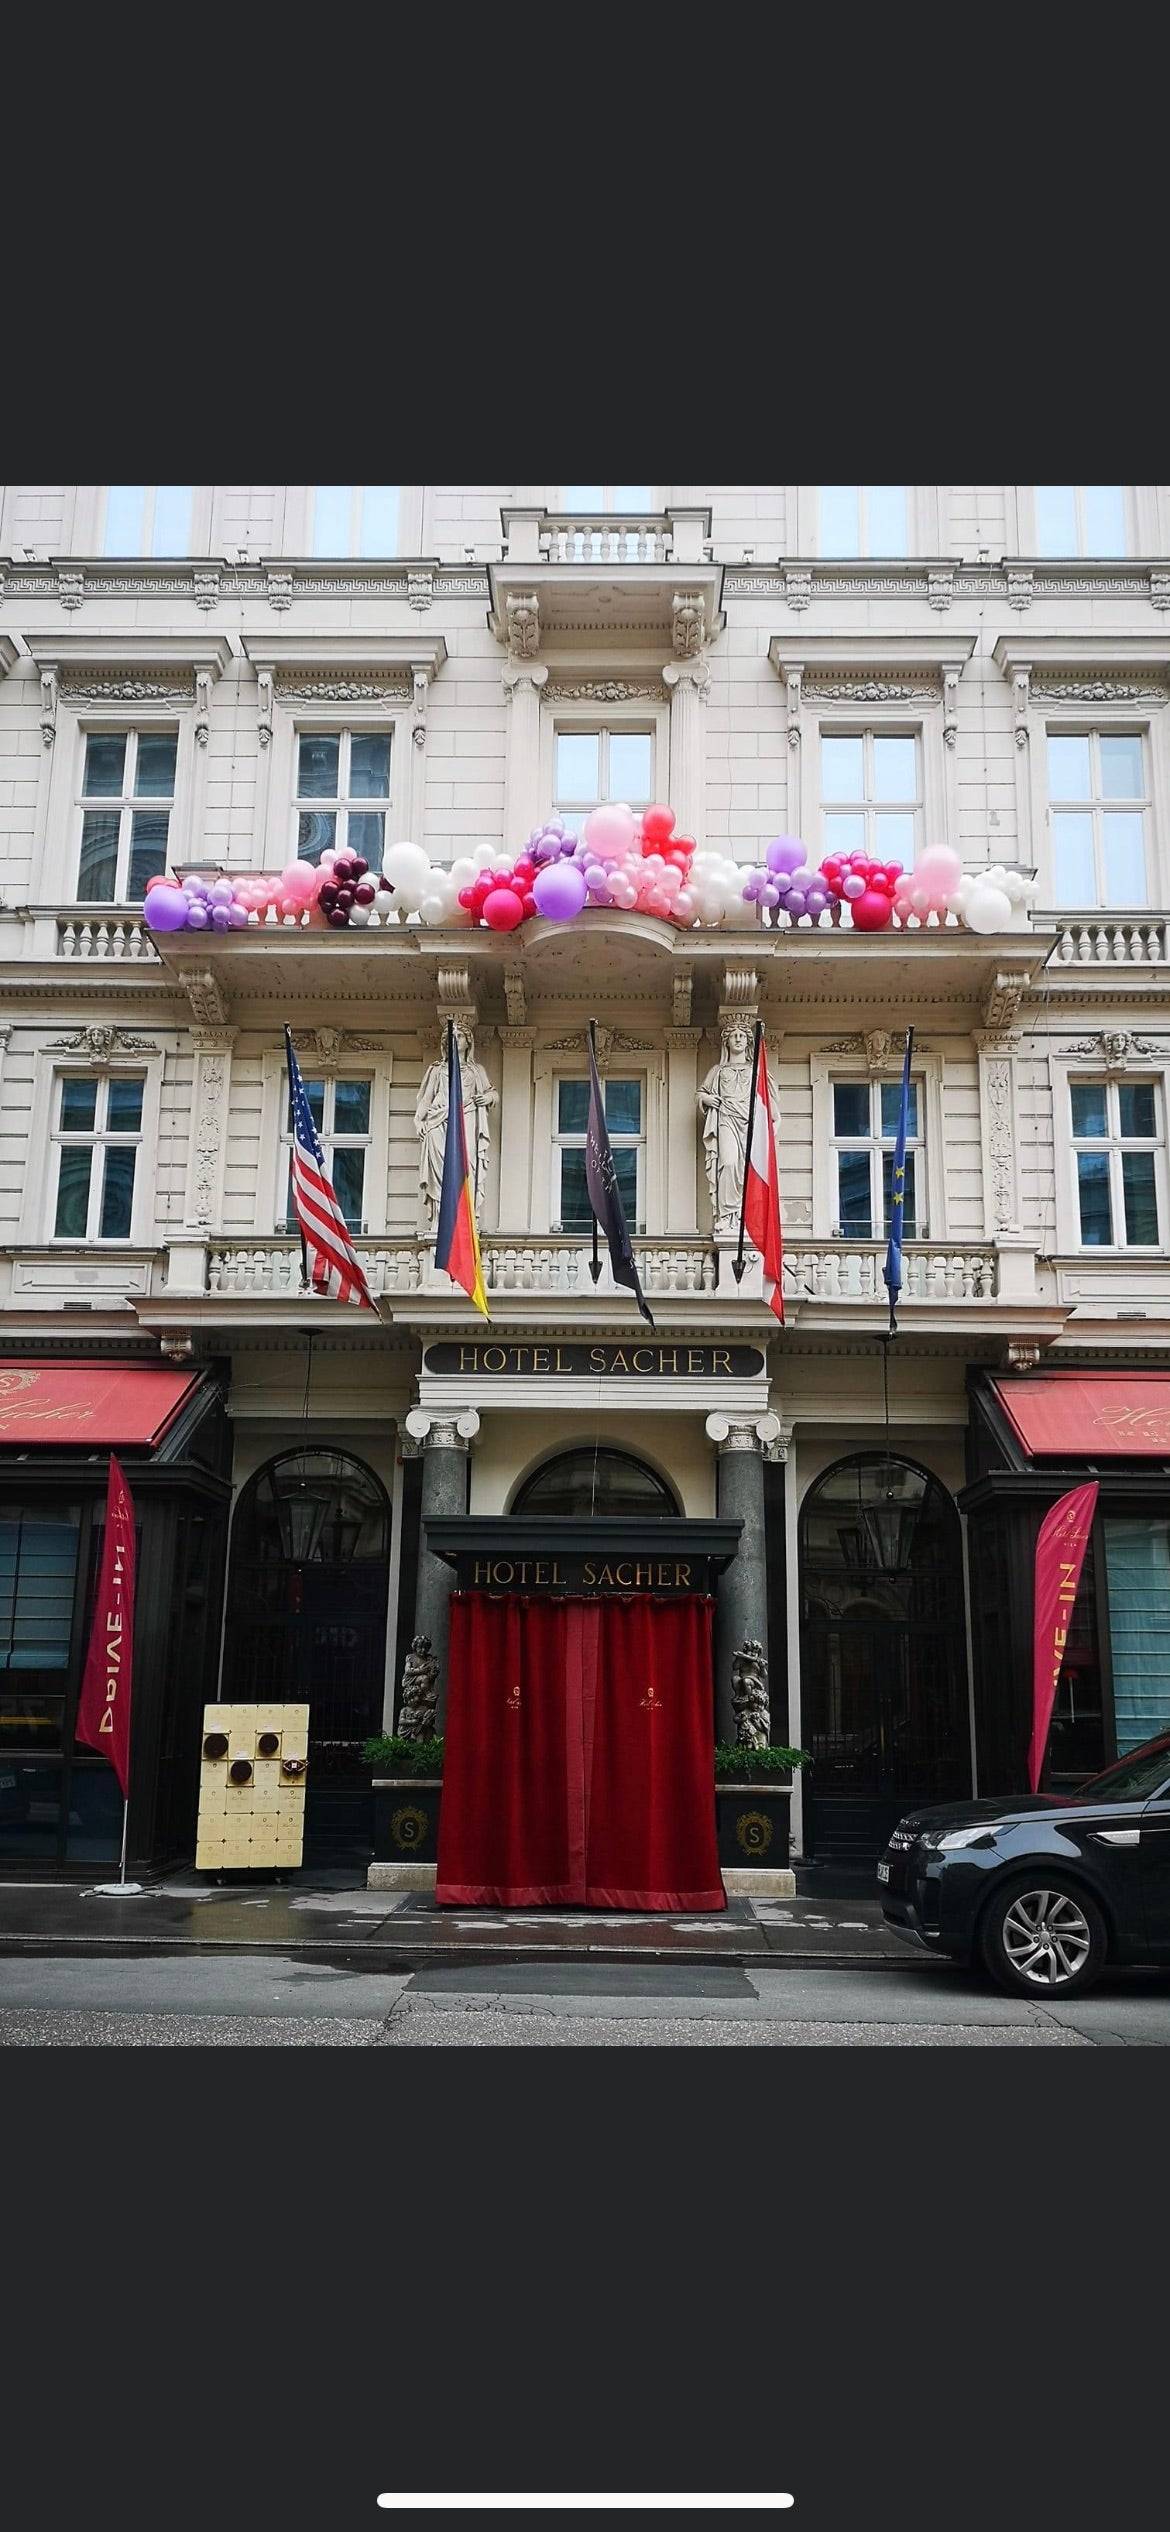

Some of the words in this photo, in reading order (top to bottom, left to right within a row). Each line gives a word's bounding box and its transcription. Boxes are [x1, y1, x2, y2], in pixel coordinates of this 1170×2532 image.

[459, 1347, 573, 1372] HOTEL
[589, 1348, 734, 1374] SACHER
[474, 1561, 567, 1585] HOTEL
[582, 1562, 692, 1586] SACHER
[1053, 1563, 1077, 1687] VE-IN
[404, 1821, 415, 1838] S
[749, 1827, 760, 1843] S
